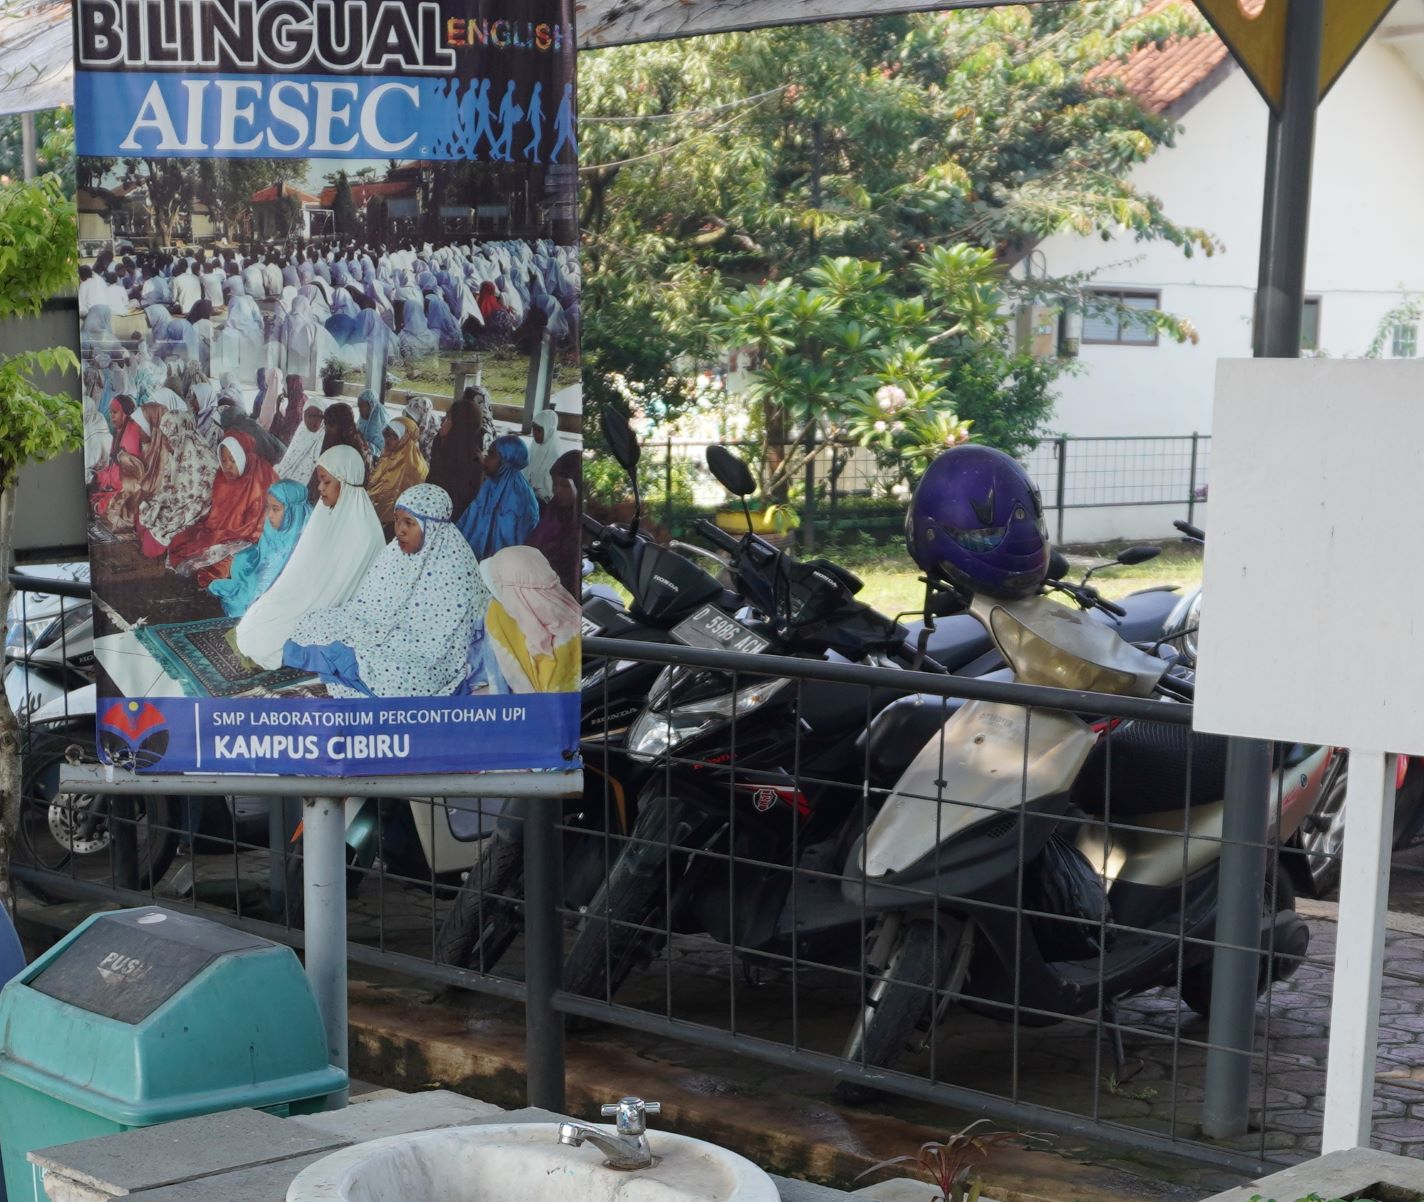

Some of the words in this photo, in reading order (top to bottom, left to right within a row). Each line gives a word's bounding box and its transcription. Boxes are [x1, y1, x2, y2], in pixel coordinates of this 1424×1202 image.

[80, 0, 456, 71] BILINGUAL
[446, 17, 574, 51] ENGLISH
[119, 79, 420, 152] AIESEC
[653, 574, 679, 593] HONDA
[812, 570, 838, 589] HONDA
[213, 712, 245, 727] SMP
[250, 711, 374, 726] LABORATORIUM
[379, 708, 497, 725] PERCONTOHAN
[502, 707, 526, 721] UPI
[214, 735, 319, 760] KAMPUS
[326, 733, 410, 760] CIBIRU
[99, 952, 153, 980] PUSH
